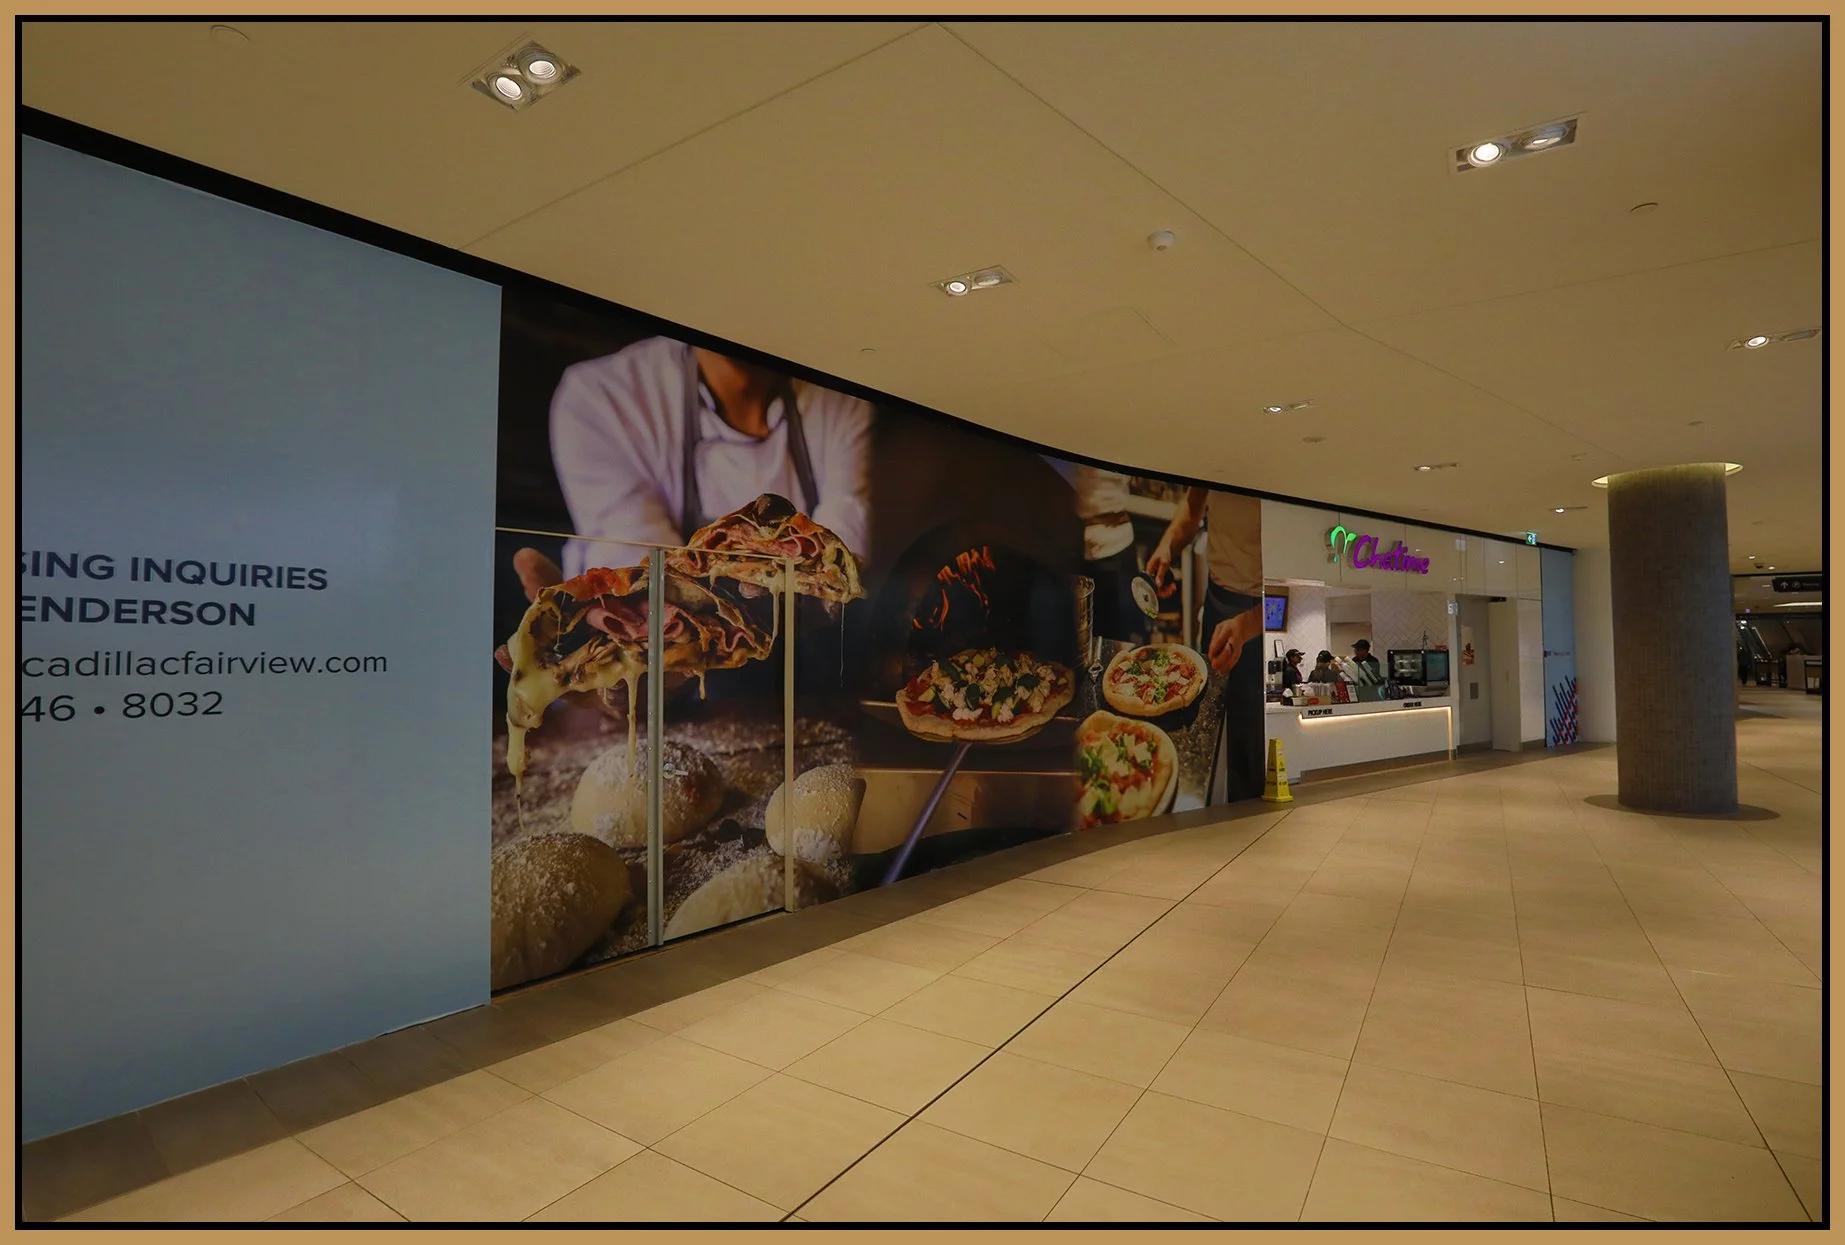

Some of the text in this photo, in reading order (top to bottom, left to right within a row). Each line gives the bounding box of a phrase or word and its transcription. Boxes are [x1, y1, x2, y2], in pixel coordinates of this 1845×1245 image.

[22, 551, 328, 591] ING INQUIRIES
[1353, 535, 1430, 574] Chatime
[22, 650, 388, 677] cadillacfairview.com
[22, 691, 223, 722] 46 8032
